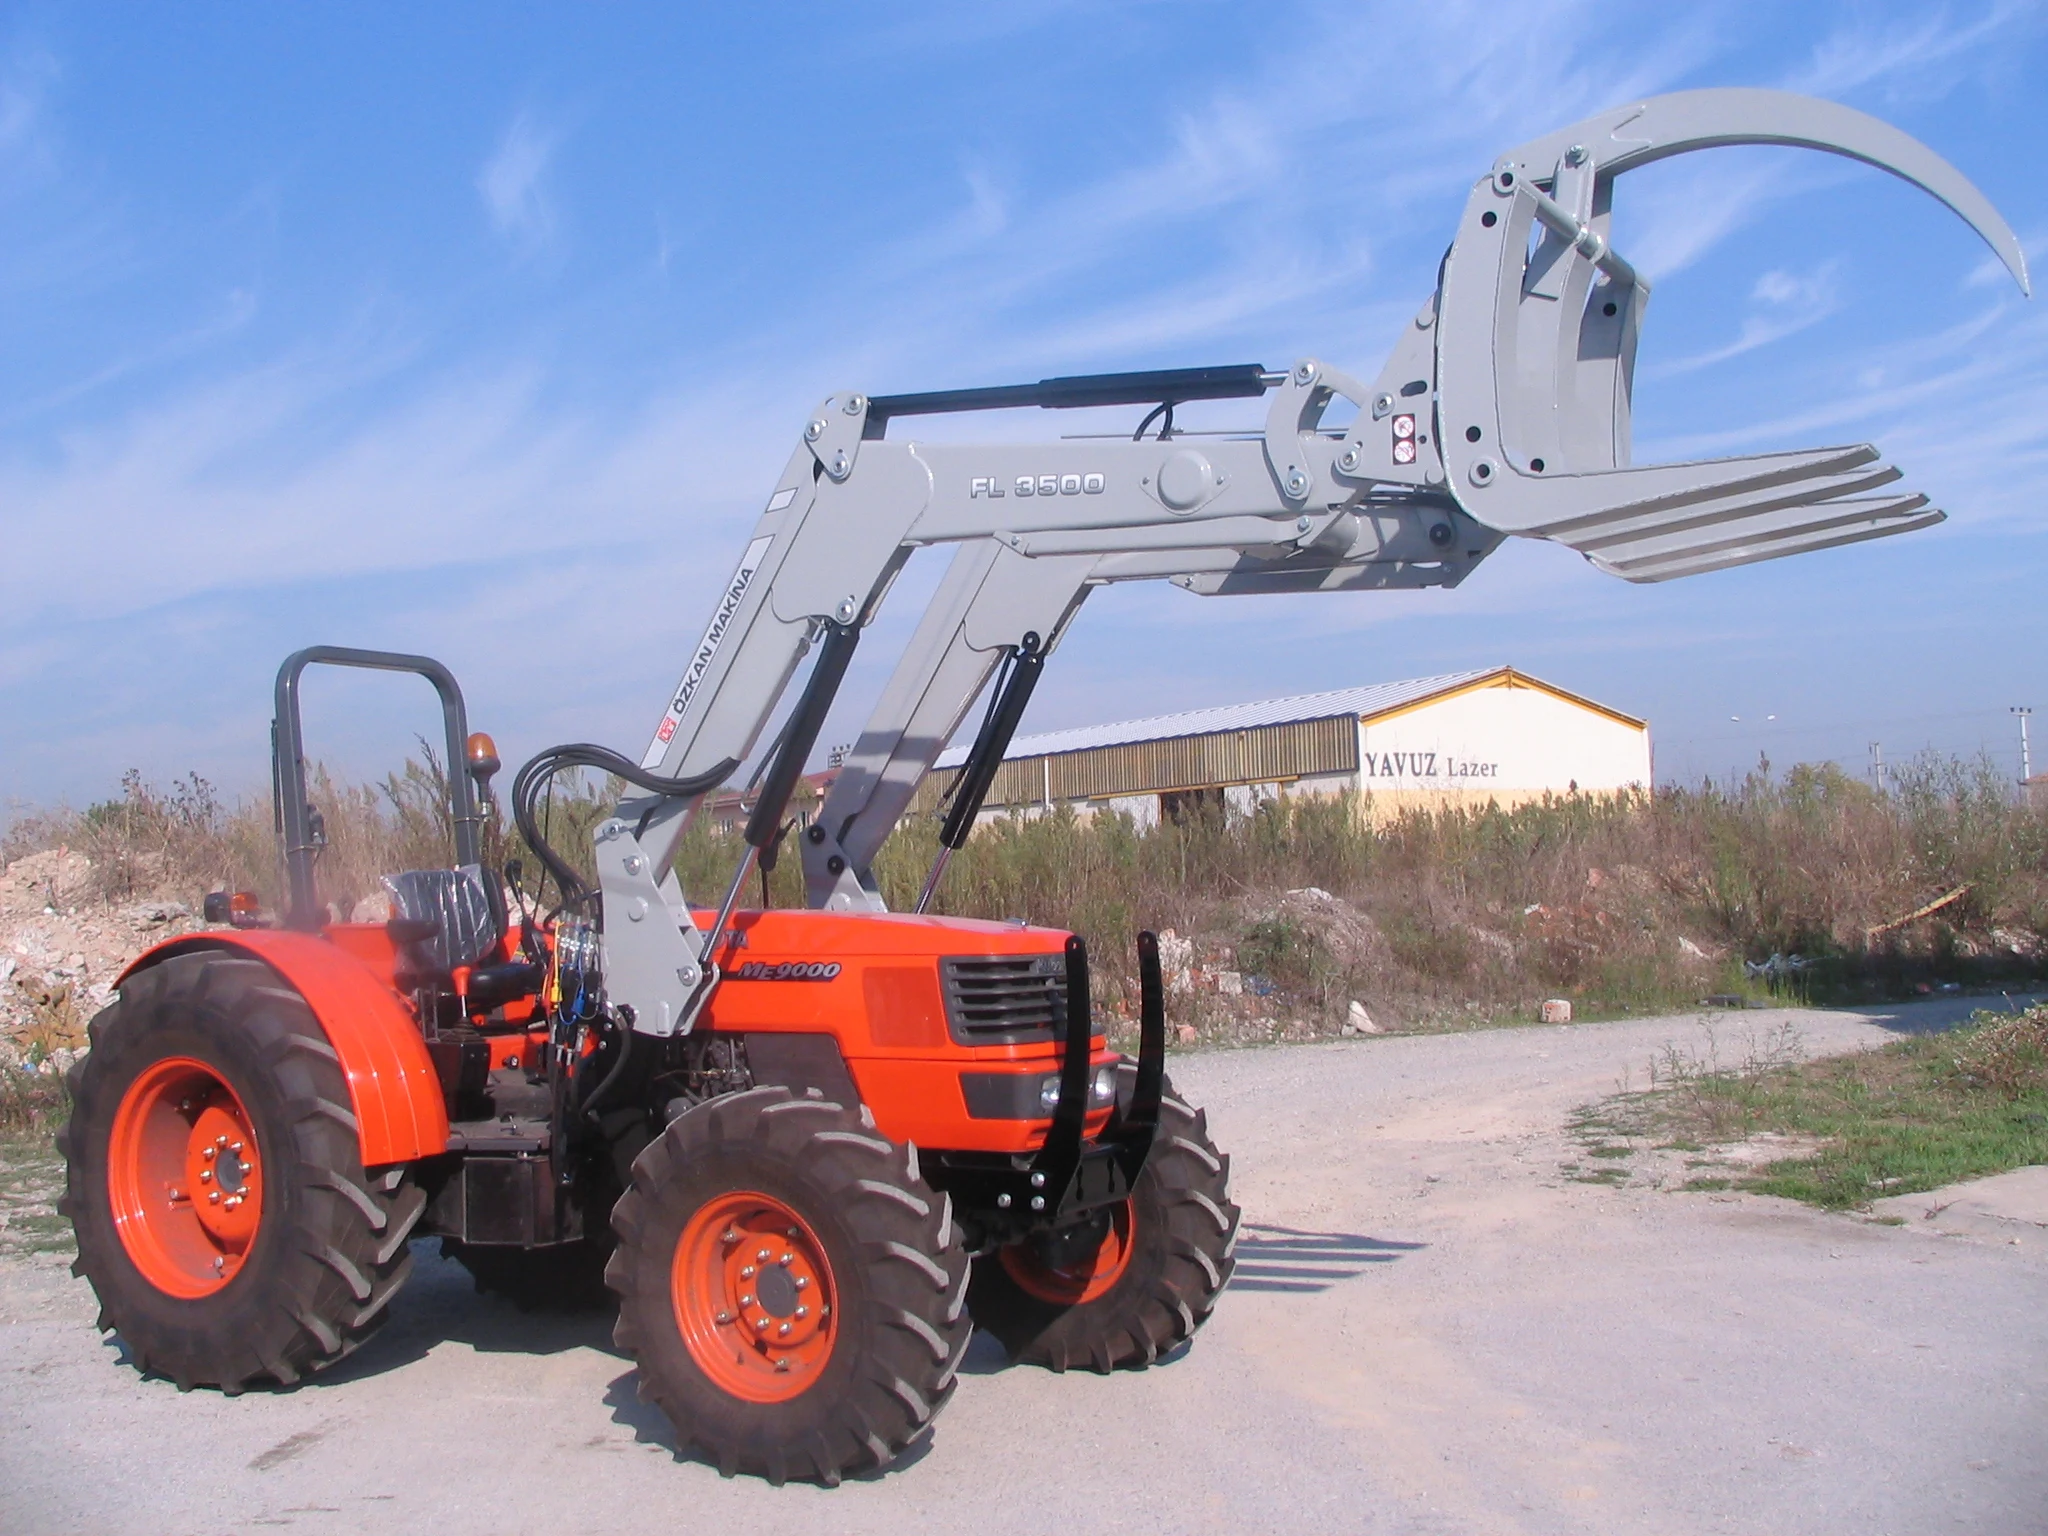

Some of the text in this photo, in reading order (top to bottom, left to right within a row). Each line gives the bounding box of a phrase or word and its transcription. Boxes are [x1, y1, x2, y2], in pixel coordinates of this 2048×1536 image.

[970, 472, 1106, 499] FL 3500
[673, 567, 754, 715] ÖZKAN MAKİNA
[1364, 752, 1498, 777] YAVUZ Lazer
